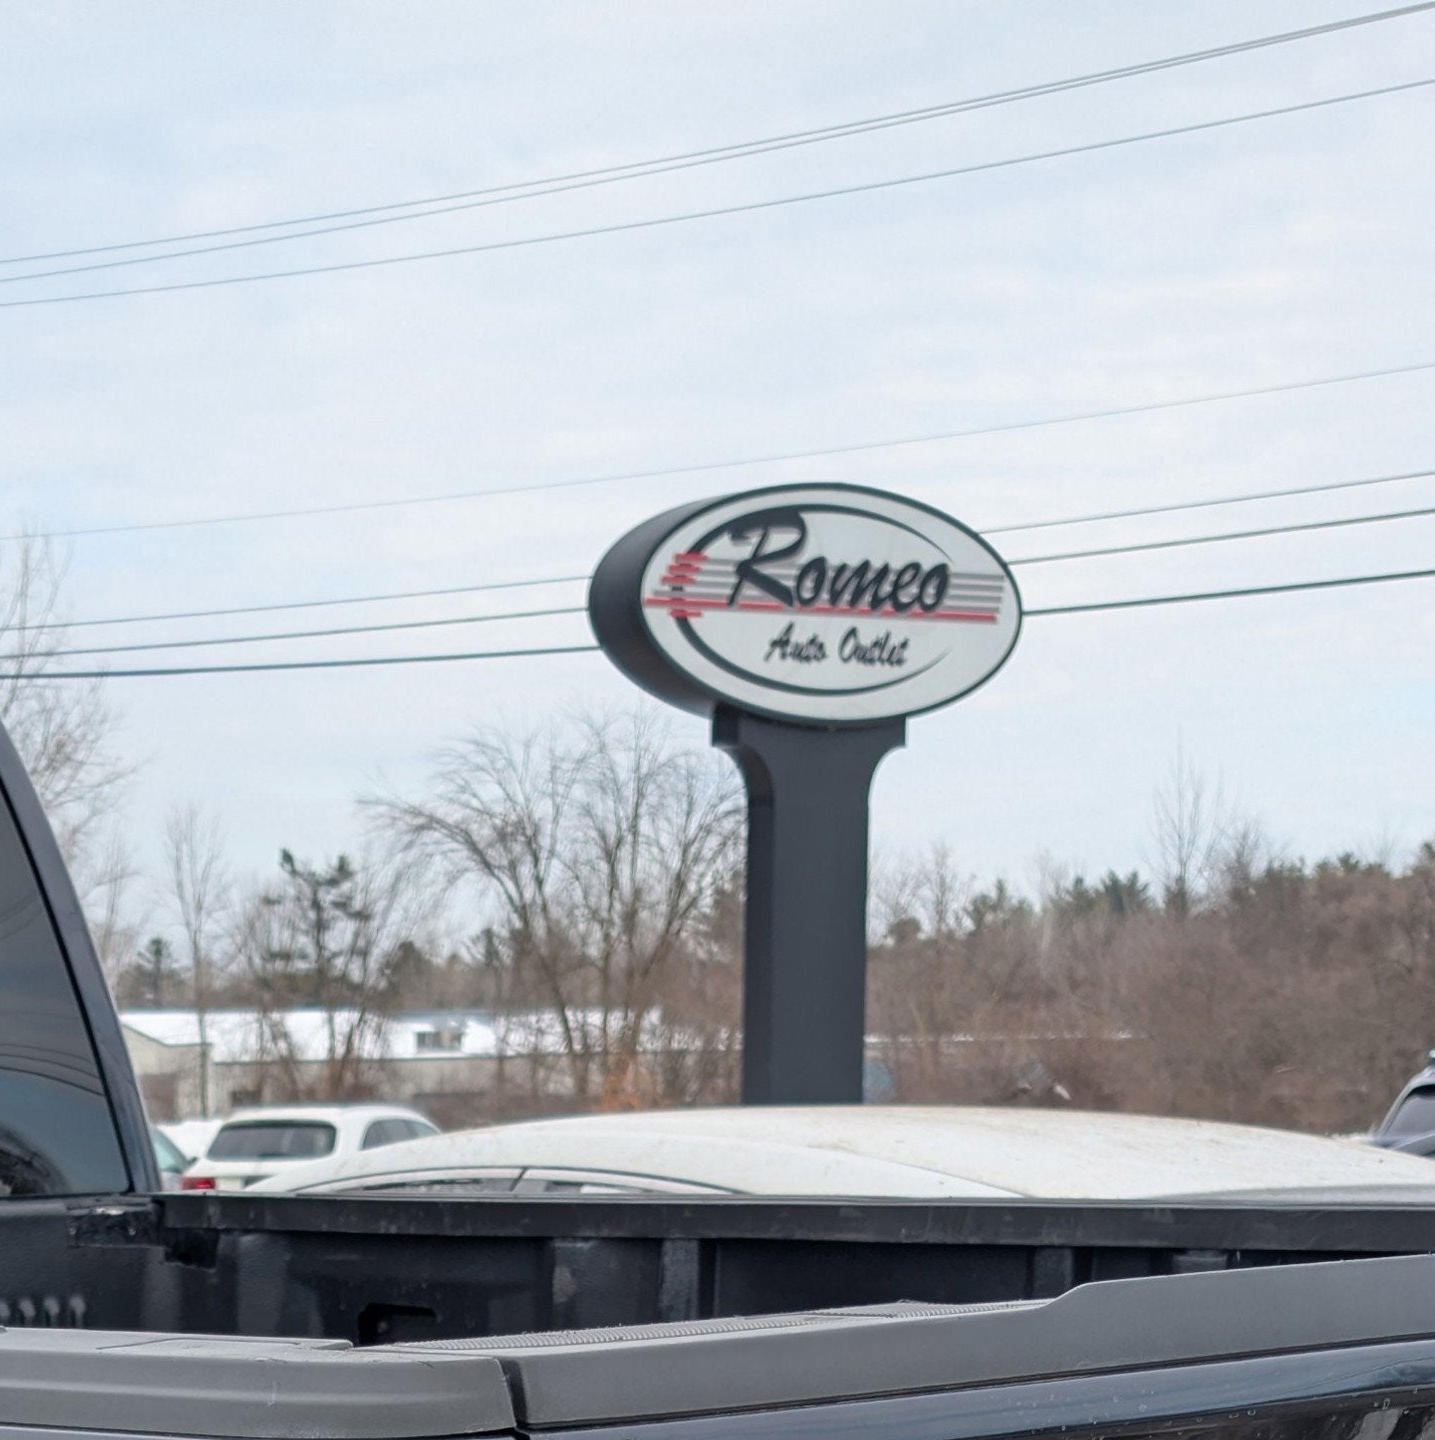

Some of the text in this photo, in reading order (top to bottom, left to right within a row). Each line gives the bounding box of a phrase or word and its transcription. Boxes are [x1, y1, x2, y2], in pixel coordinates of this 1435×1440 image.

[727, 510, 950, 614] Romeo
[763, 622, 911, 668] Auto Outlet
